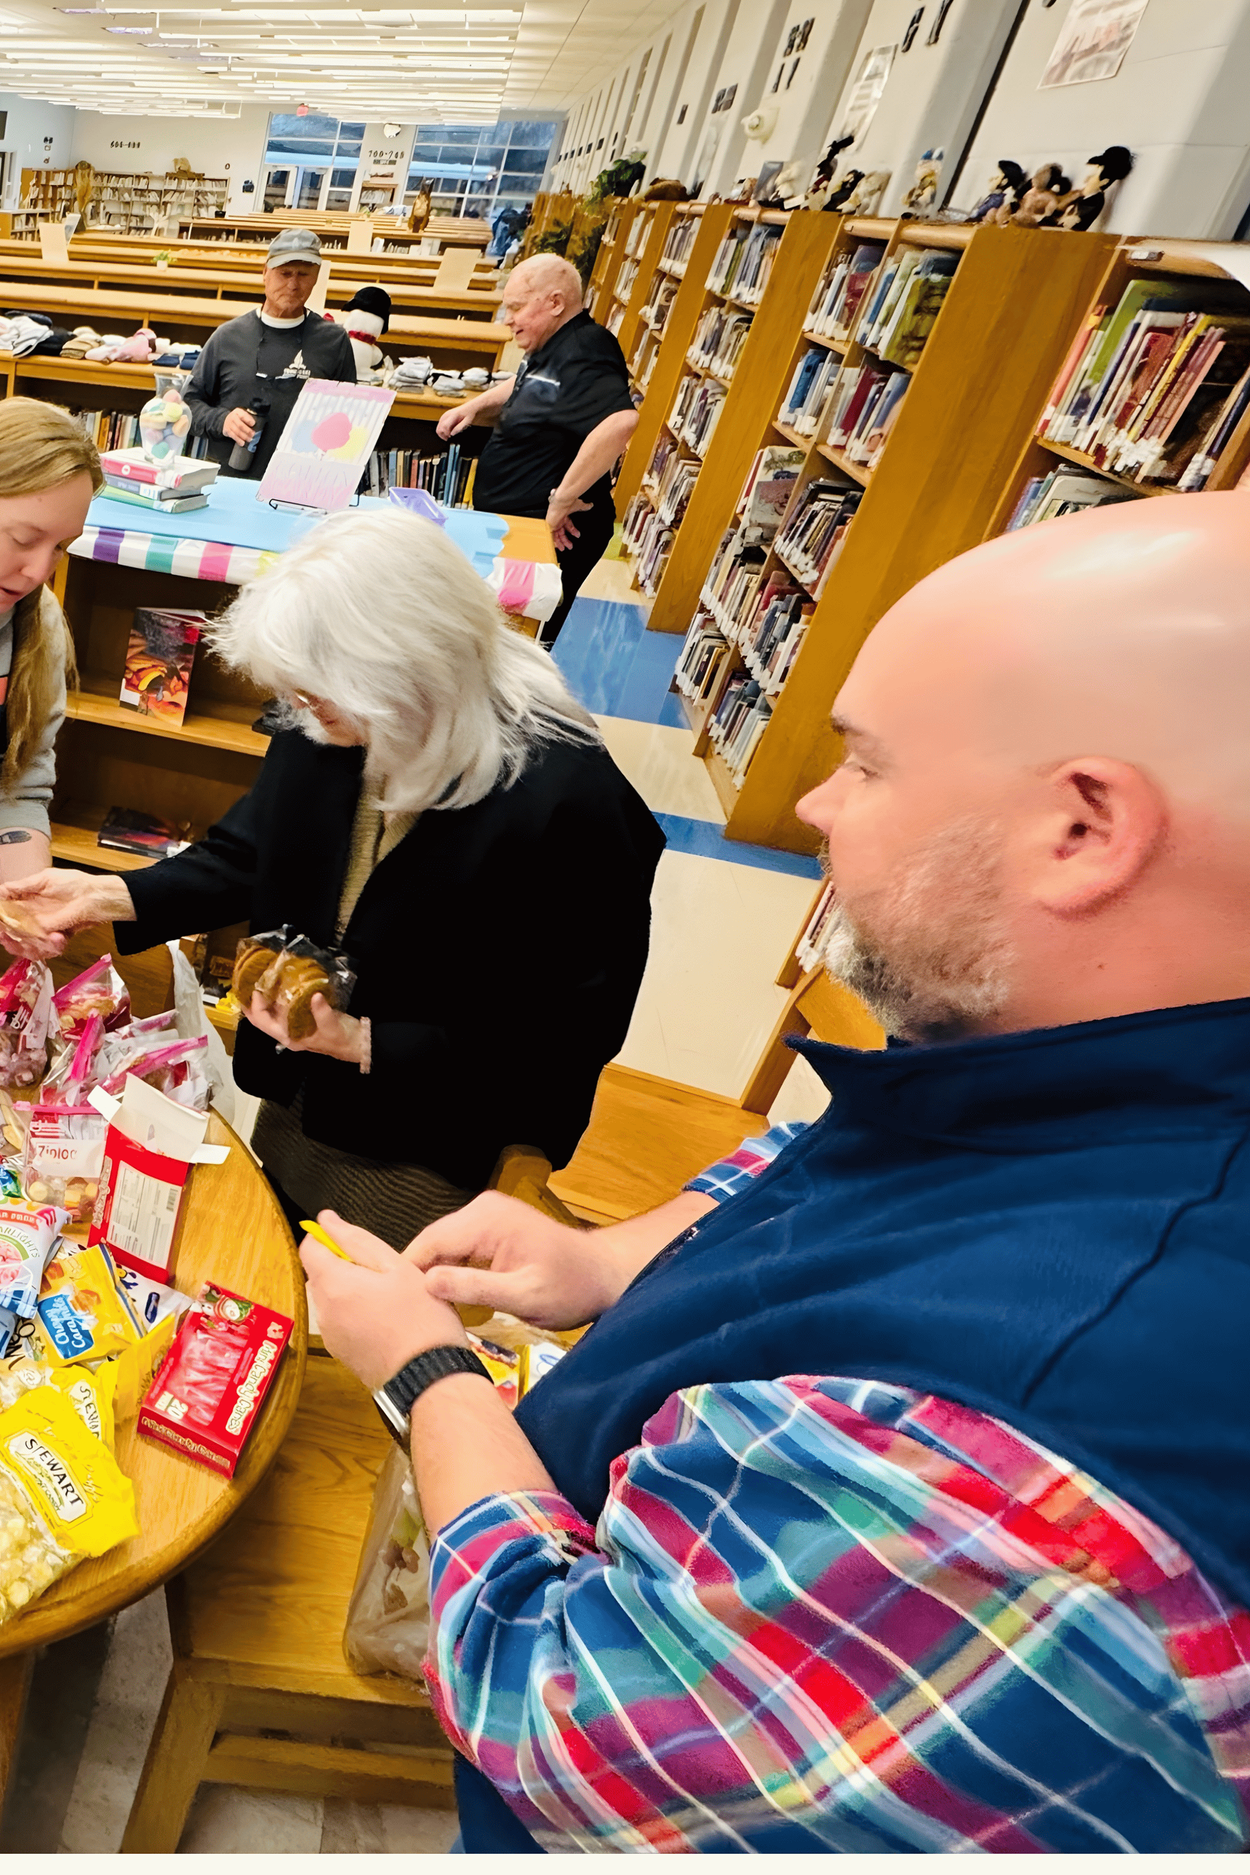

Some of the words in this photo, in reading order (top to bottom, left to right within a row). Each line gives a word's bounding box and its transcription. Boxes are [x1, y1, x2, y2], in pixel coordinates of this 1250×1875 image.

[237, 1361, 268, 1397] Candy
[166, 1398, 189, 1420] 20
[24, 1438, 84, 1506] STEWART
